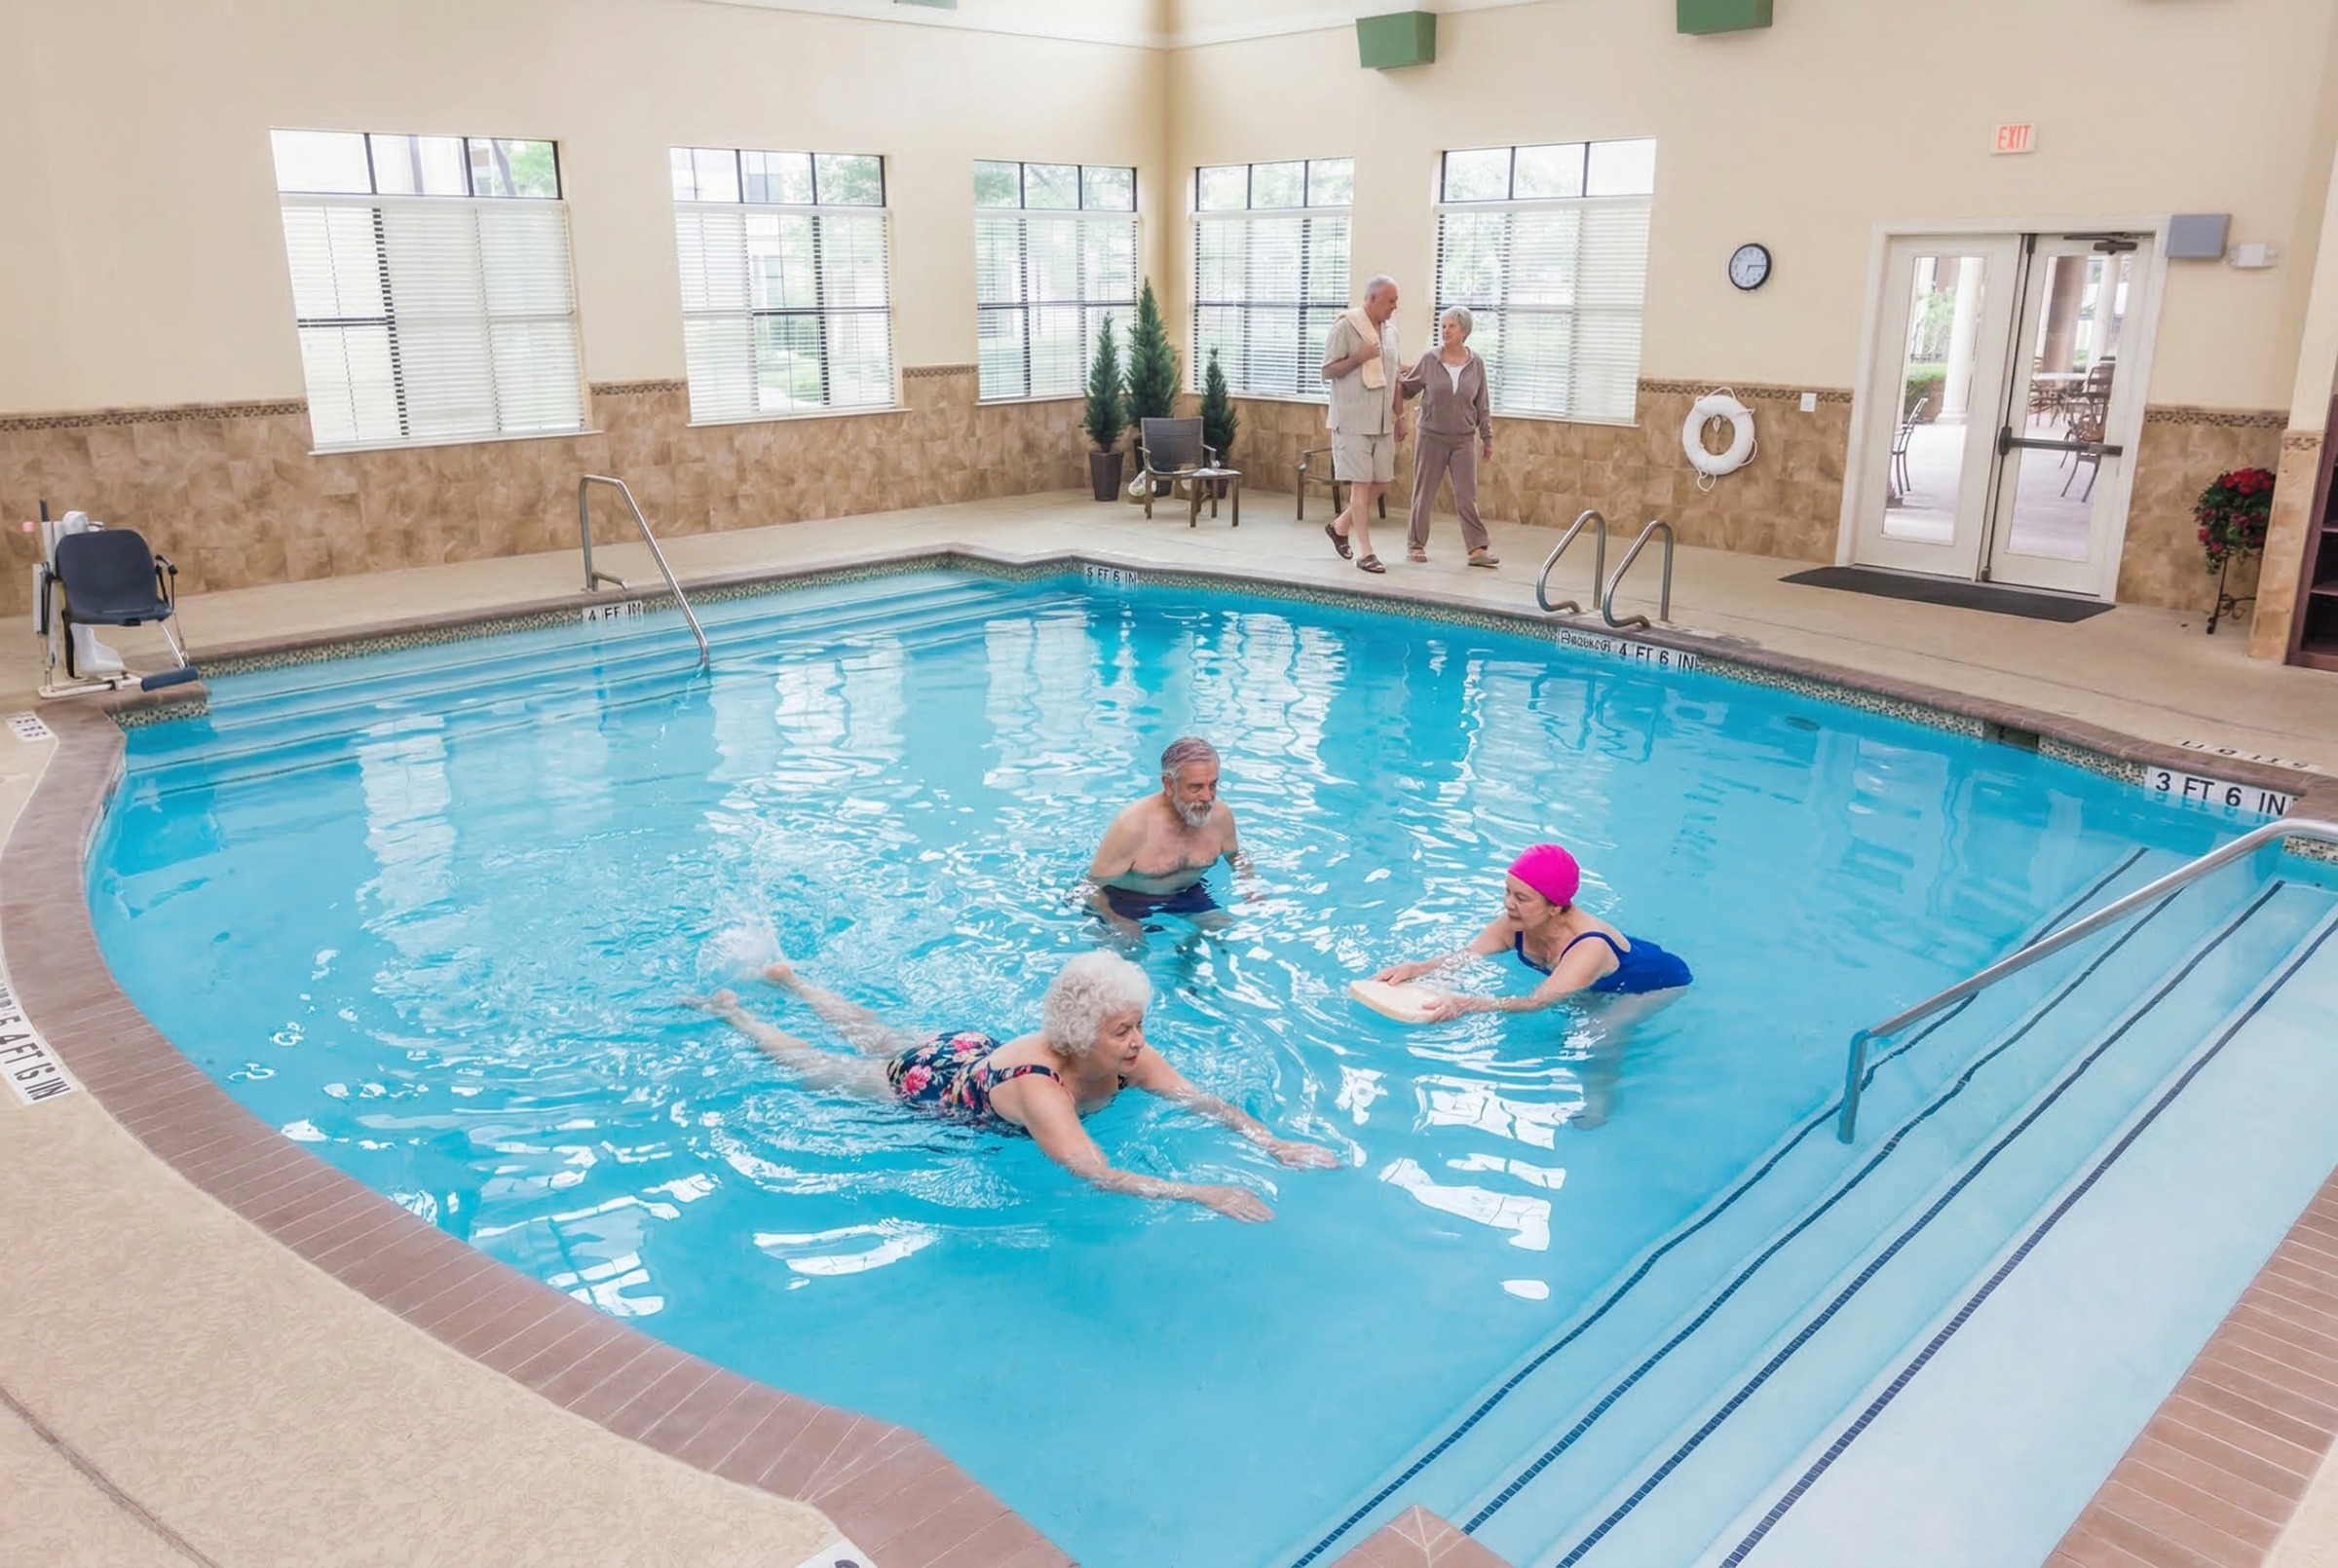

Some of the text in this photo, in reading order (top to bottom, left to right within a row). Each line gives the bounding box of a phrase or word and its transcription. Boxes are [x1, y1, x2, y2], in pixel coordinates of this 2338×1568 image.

[1998, 125, 2032, 150] EXIT
[1619, 643, 1627, 656] 4
[1659, 651, 1669, 665] 6
[1678, 653, 1695, 670] IN
[2156, 771, 2287, 816] 3 FT 6 IN
